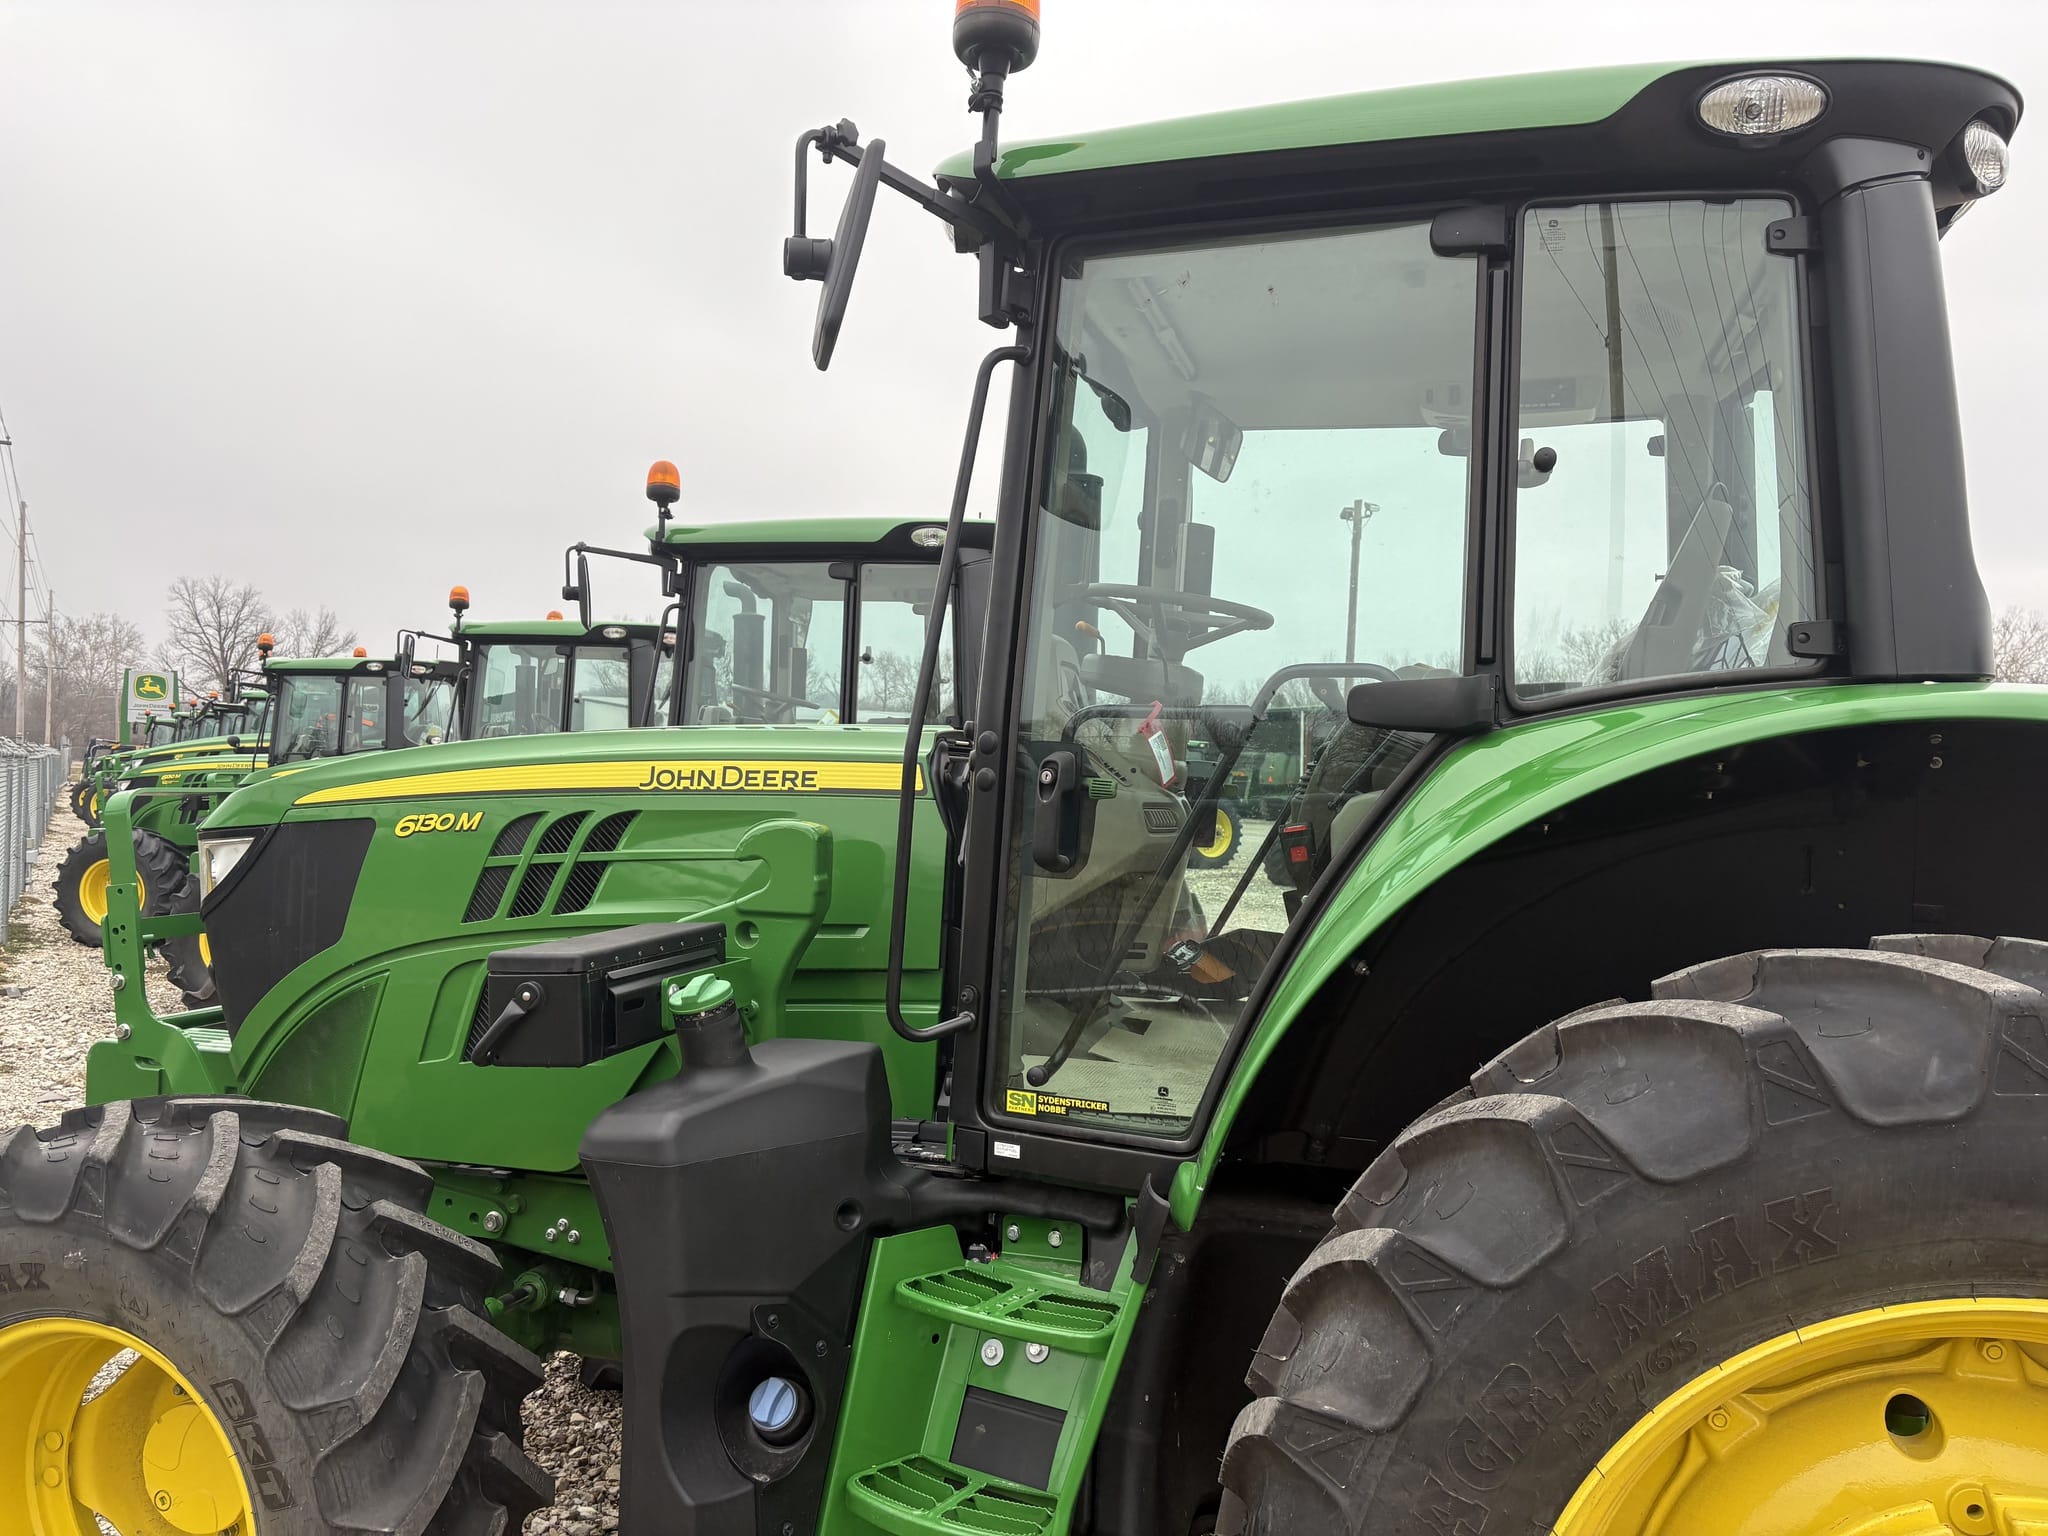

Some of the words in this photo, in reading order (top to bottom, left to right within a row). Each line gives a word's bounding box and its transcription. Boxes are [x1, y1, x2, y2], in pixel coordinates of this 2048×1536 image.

[639, 765, 716, 788] JOHN
[721, 765, 818, 788] DEERE
[1008, 1092, 1035, 1108] SN
[1038, 1094, 1108, 1112] SYDENSTRICKER
[1038, 1103, 1067, 1115] NOBBE
[1411, 1313, 1599, 1536] AGRI
[1592, 1186, 1841, 1354] MAX
[1562, 1379, 1623, 1452] RT
[1619, 1322, 1699, 1401] 765
[209, 1377, 298, 1512] BKT
